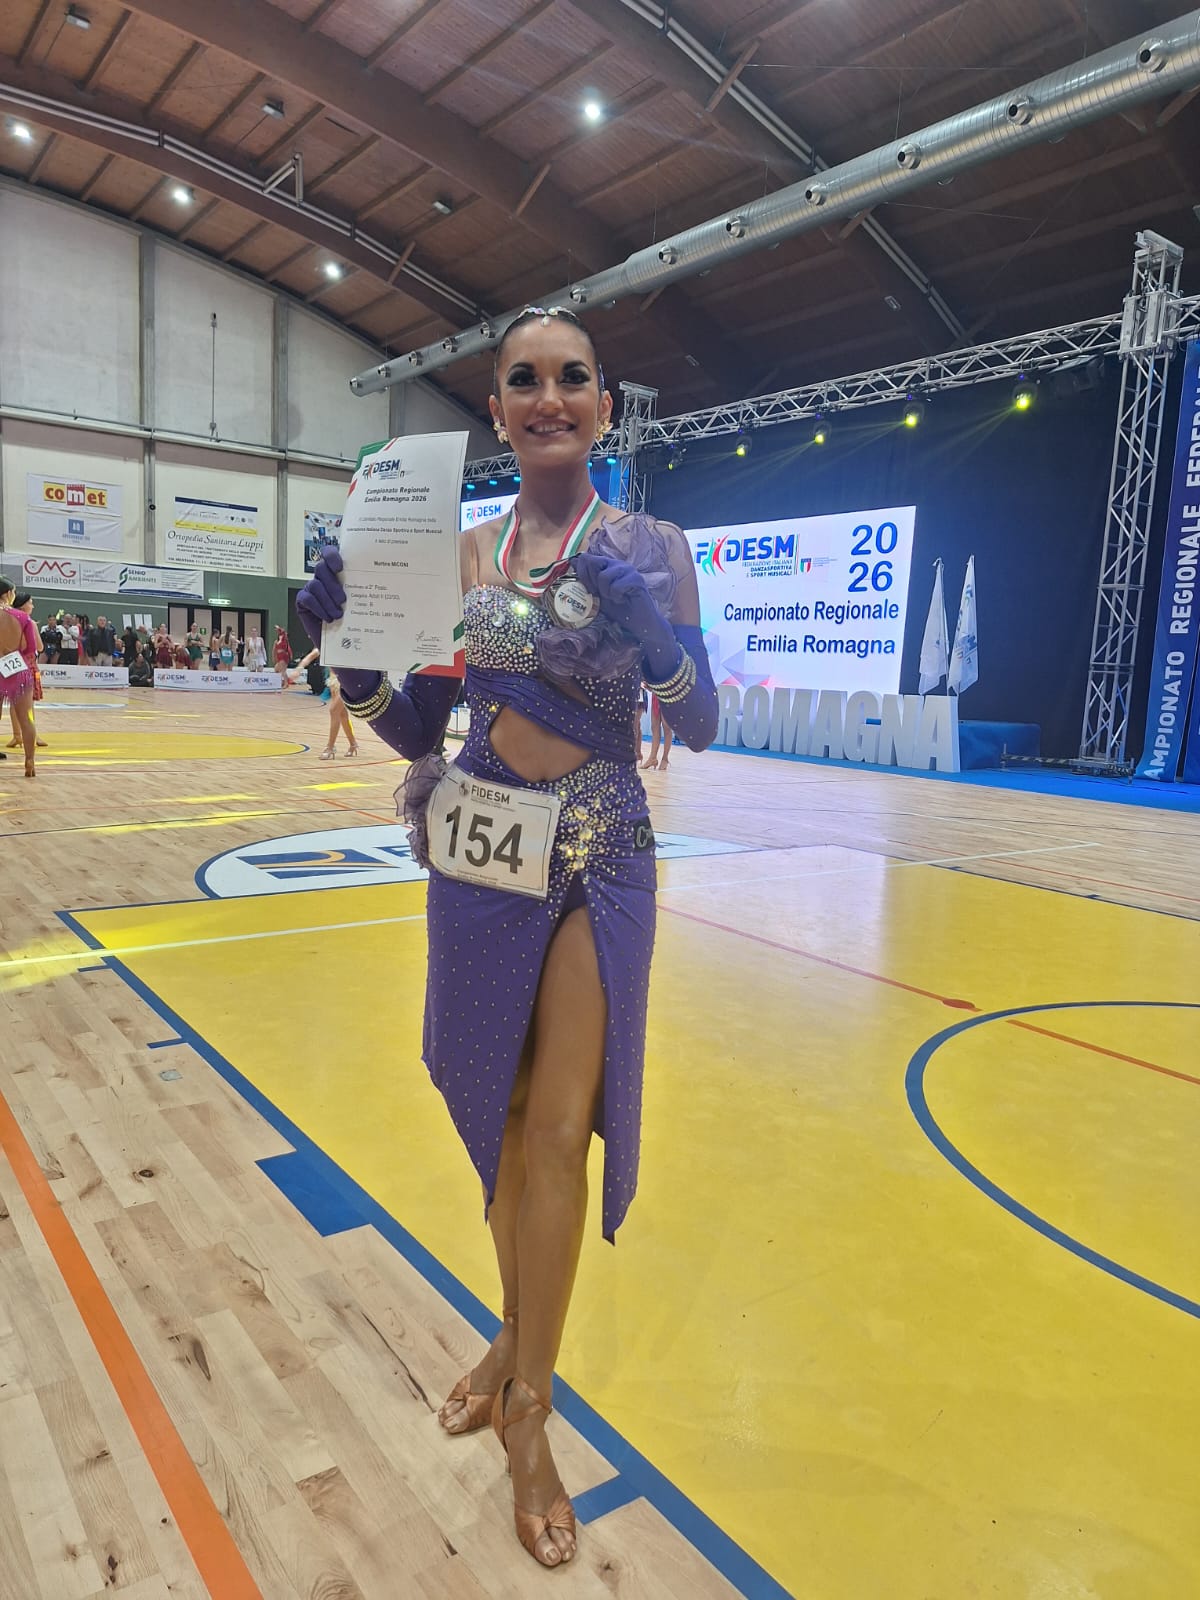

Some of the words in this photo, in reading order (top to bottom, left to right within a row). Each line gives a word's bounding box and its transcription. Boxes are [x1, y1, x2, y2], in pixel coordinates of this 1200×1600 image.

[45, 487, 106, 506] comet
[382, 495, 410, 503] Romagna
[400, 486, 430, 494] Regionale
[168, 530, 203, 544] Ortopedia
[204, 535, 236, 546] Sanitaria
[238, 538, 264, 552] Luppi
[851, 521, 898, 556] 20
[24, 559, 76, 578] CMG
[25, 574, 76, 585] granulators
[847, 560, 893, 593] 26
[724, 602, 810, 625] Campionato
[814, 599, 899, 625] Regionale
[747, 634, 797, 652] Emilia
[803, 634, 895, 658] Romagna
[1144, 651, 1185, 780] AMPIONATO
[1169, 504, 1200, 634] REGIONALE
[4, 658, 22, 671] 125
[716, 684, 960, 772] ROMAGNA
[471, 784, 510, 805] FIDESM
[445, 805, 523, 874] 154
